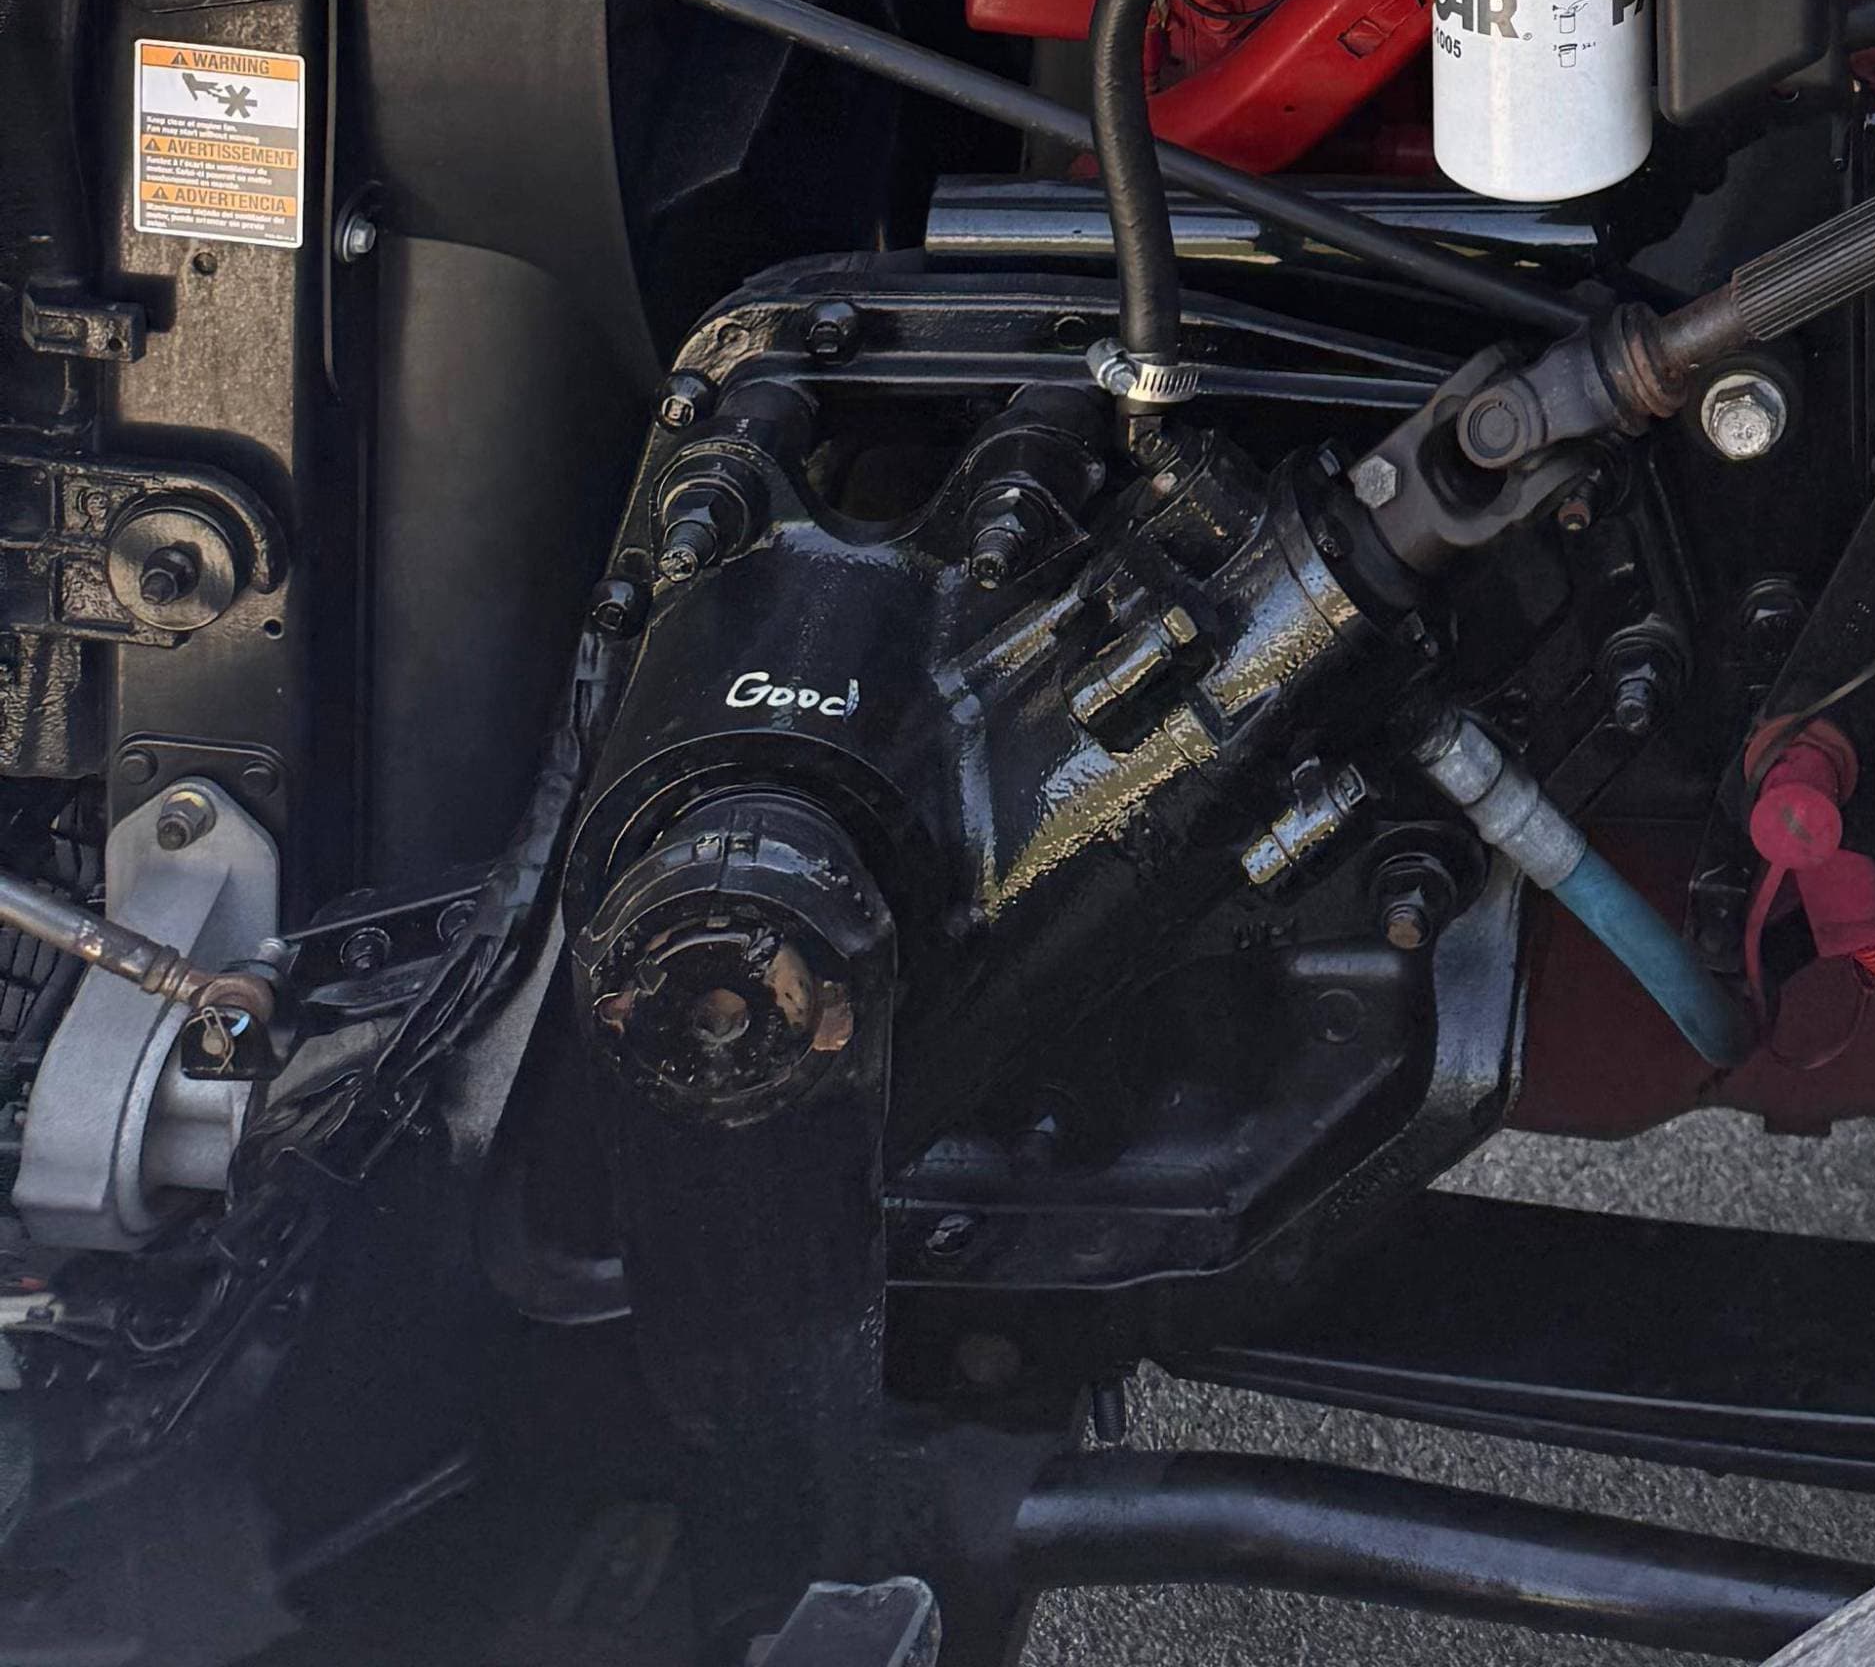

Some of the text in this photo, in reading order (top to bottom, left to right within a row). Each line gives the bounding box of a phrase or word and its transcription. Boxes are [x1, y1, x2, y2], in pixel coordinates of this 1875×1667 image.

[193, 52, 270, 75] WARNING
[168, 139, 294, 166] AVERTISSEMENT
[175, 188, 286, 212] ADVERTENCIA
[725, 671, 860, 718] Good
